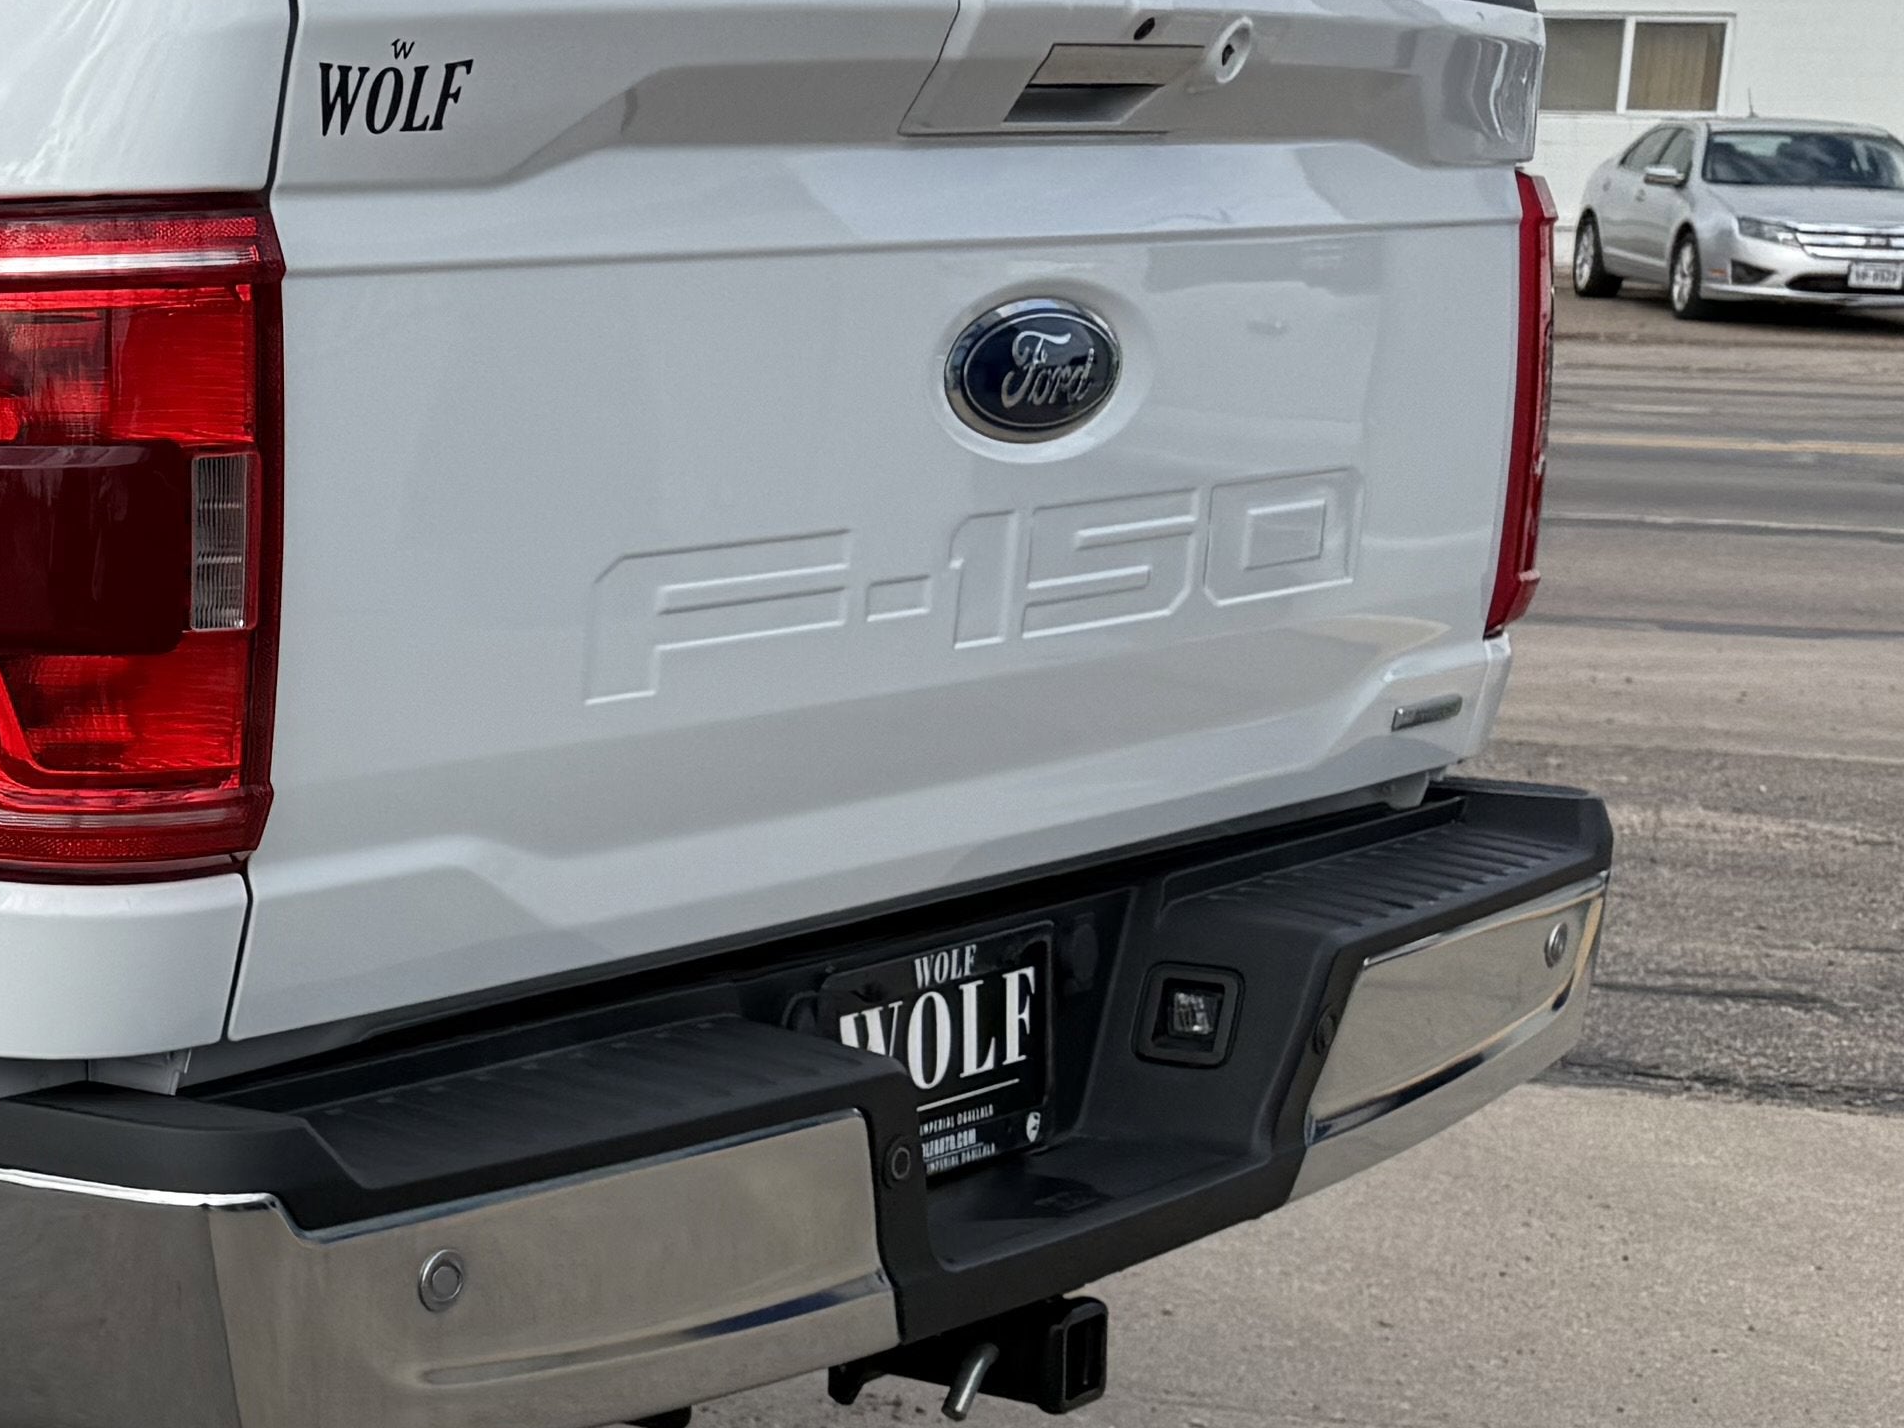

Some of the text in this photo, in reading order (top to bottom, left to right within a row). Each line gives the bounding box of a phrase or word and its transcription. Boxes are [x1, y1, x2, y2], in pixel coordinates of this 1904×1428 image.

[318, 58, 474, 137] WOLF
[1000, 330, 1095, 409] Ford
[584, 468, 1365, 705] F-150
[913, 943, 978, 989] WOLF
